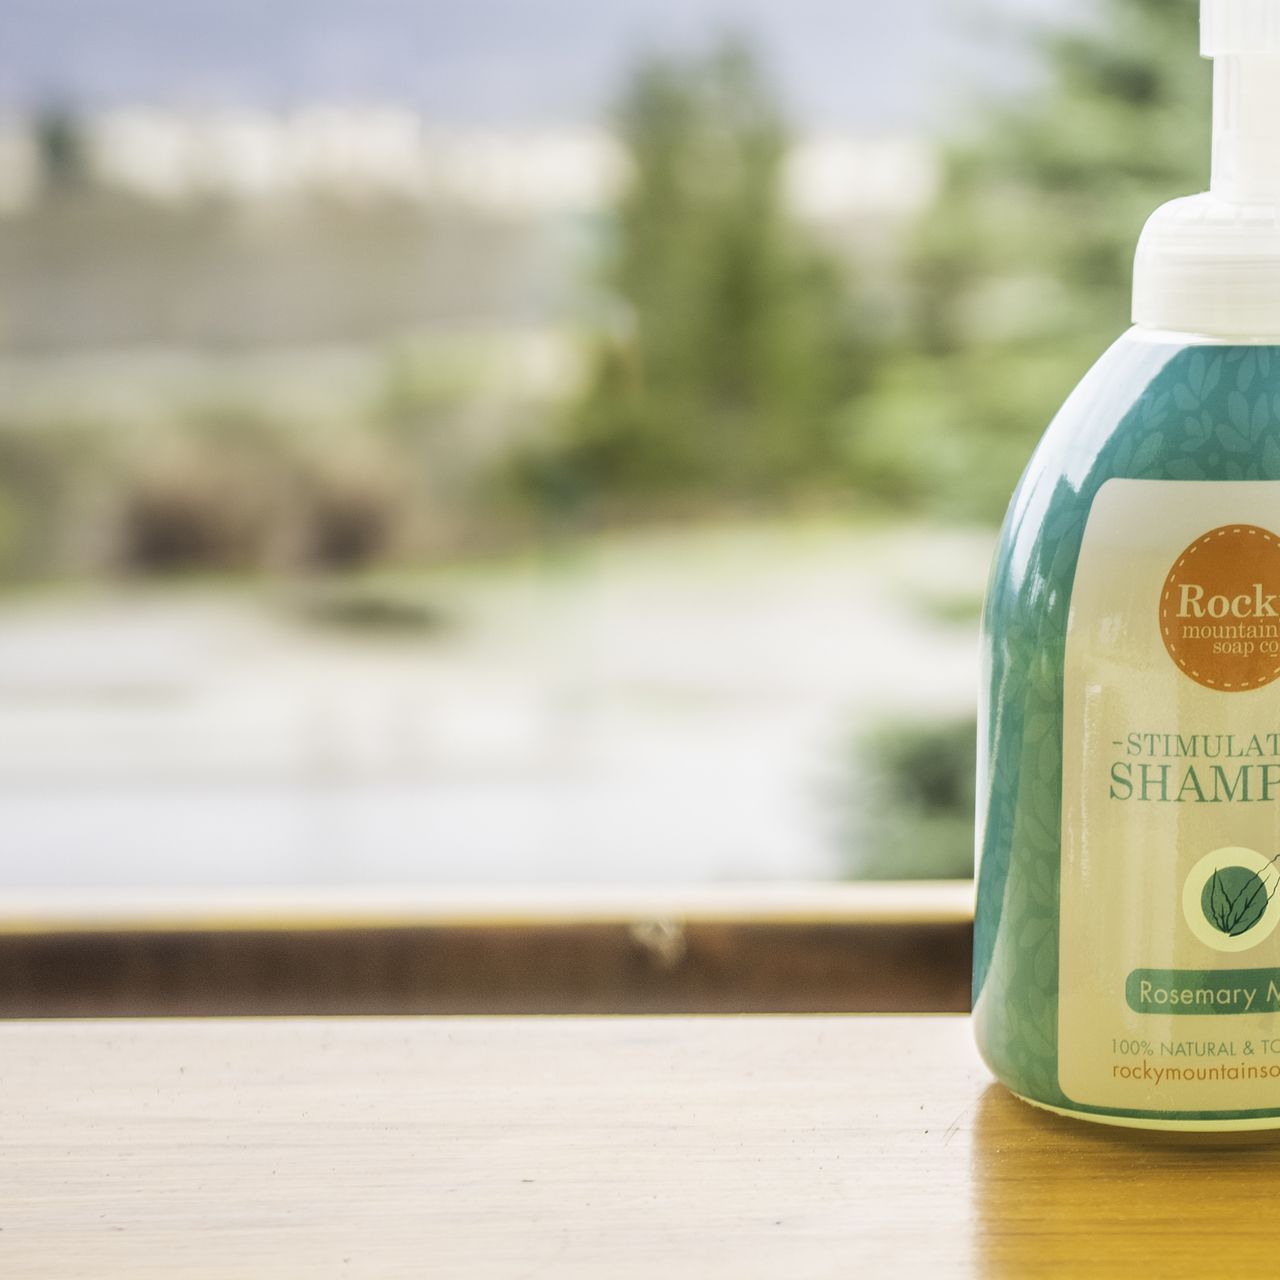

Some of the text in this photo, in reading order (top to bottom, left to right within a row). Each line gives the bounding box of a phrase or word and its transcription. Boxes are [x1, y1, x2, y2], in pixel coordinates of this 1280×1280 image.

[1183, 622, 1279, 639] mountain
[1213, 638, 1254, 657] soap
[1140, 980, 1257, 1011] Rosemary
[1111, 1038, 1154, 1057] 100%
[1160, 1040, 1237, 1058] NATURAL
[1243, 1040, 1255, 1057] &
